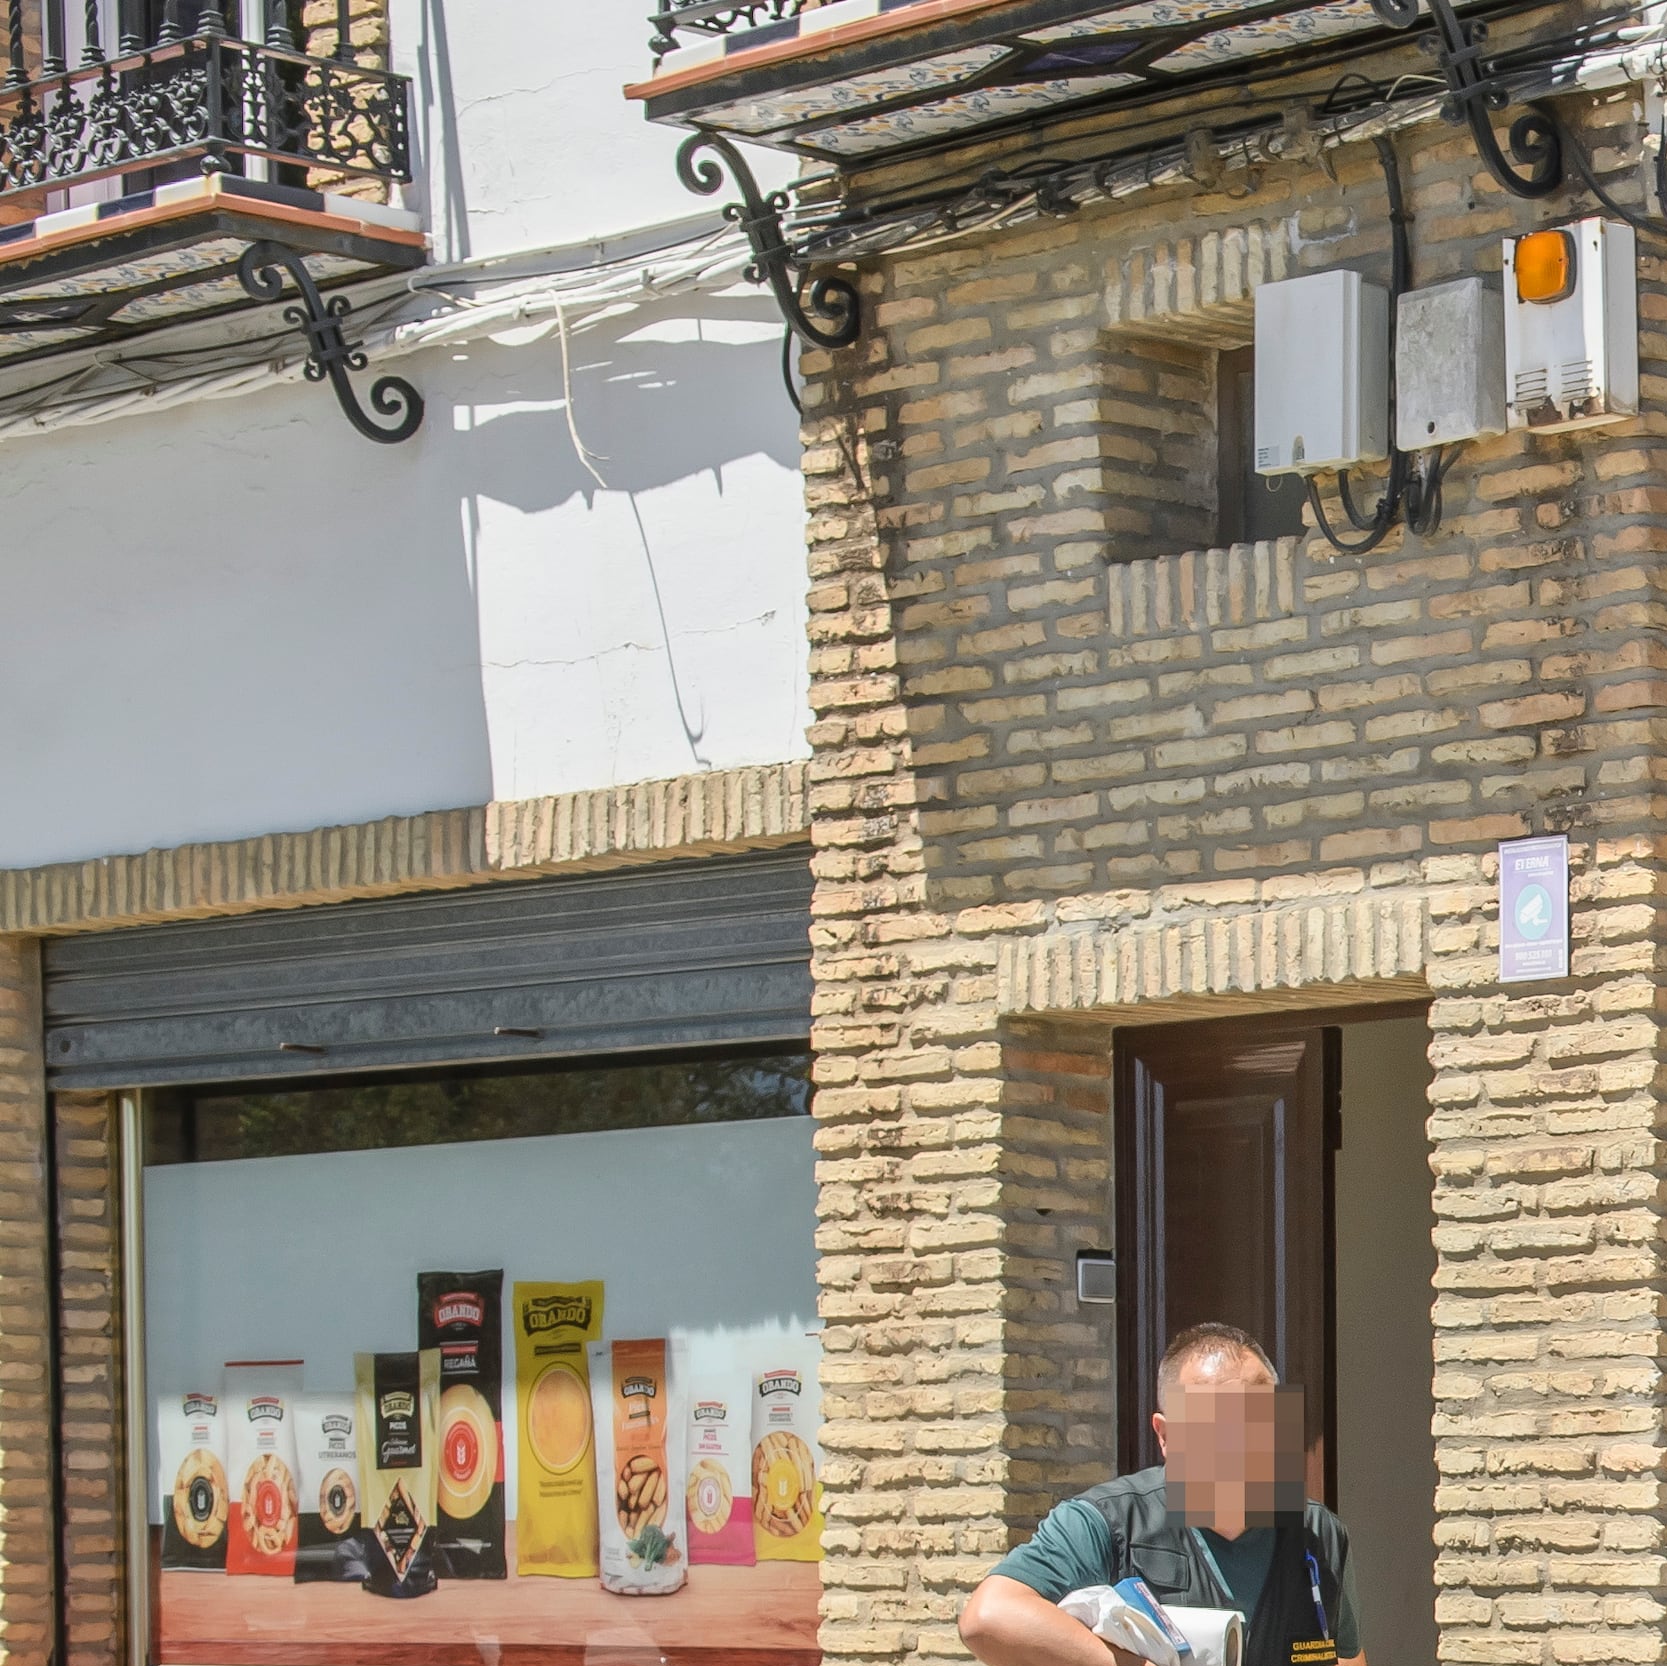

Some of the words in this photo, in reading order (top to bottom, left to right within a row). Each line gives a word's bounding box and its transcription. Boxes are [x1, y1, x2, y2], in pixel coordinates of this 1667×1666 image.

[1514, 856, 1550, 871] ETERNA
[438, 1303, 480, 1323] OBANDO
[529, 1306, 586, 1329] OBANDO
[623, 1383, 655, 1396] OBANDO
[761, 1380, 799, 1394] OBANDO
[1292, 1640, 1325, 1651] GUARDIA
